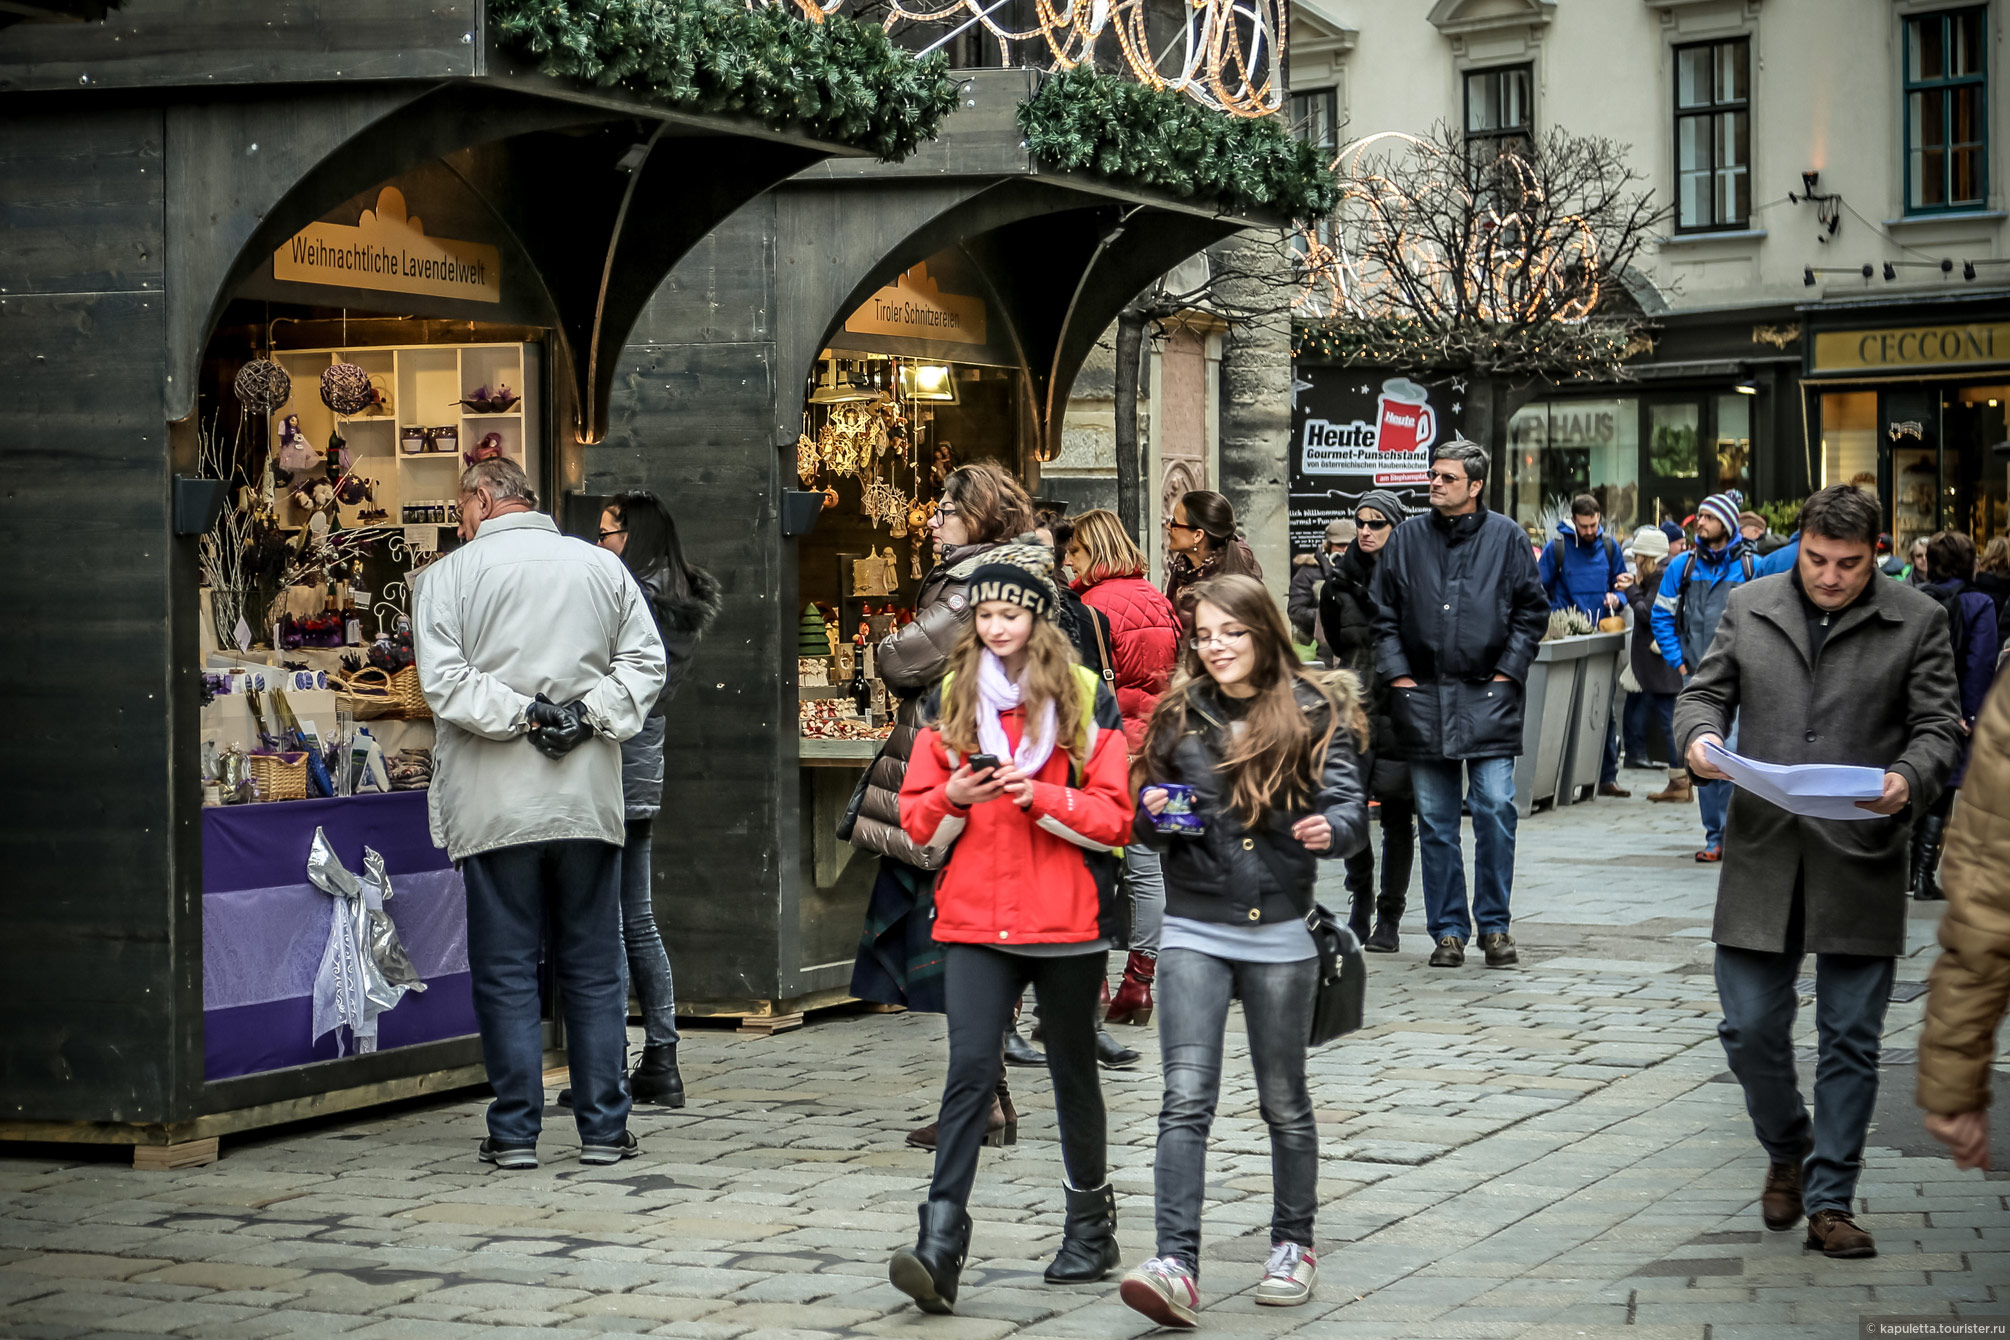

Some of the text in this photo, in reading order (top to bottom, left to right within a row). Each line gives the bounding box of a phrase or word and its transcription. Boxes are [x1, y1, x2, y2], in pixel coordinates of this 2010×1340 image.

[291, 236, 486, 285] Weihnachtliche Lavendelwelt
[874, 298, 960, 329] Tiroler Schnitzereien
[1858, 328, 1994, 363] CECCONI
[1385, 411, 1416, 427] Heute
[1307, 424, 1376, 447] Heute
[1306, 448, 1427, 461] Gourmet-Punschstand
[1321, 461, 1377, 470] österreichischen
[1378, 461, 1428, 470] Haubenköchen
